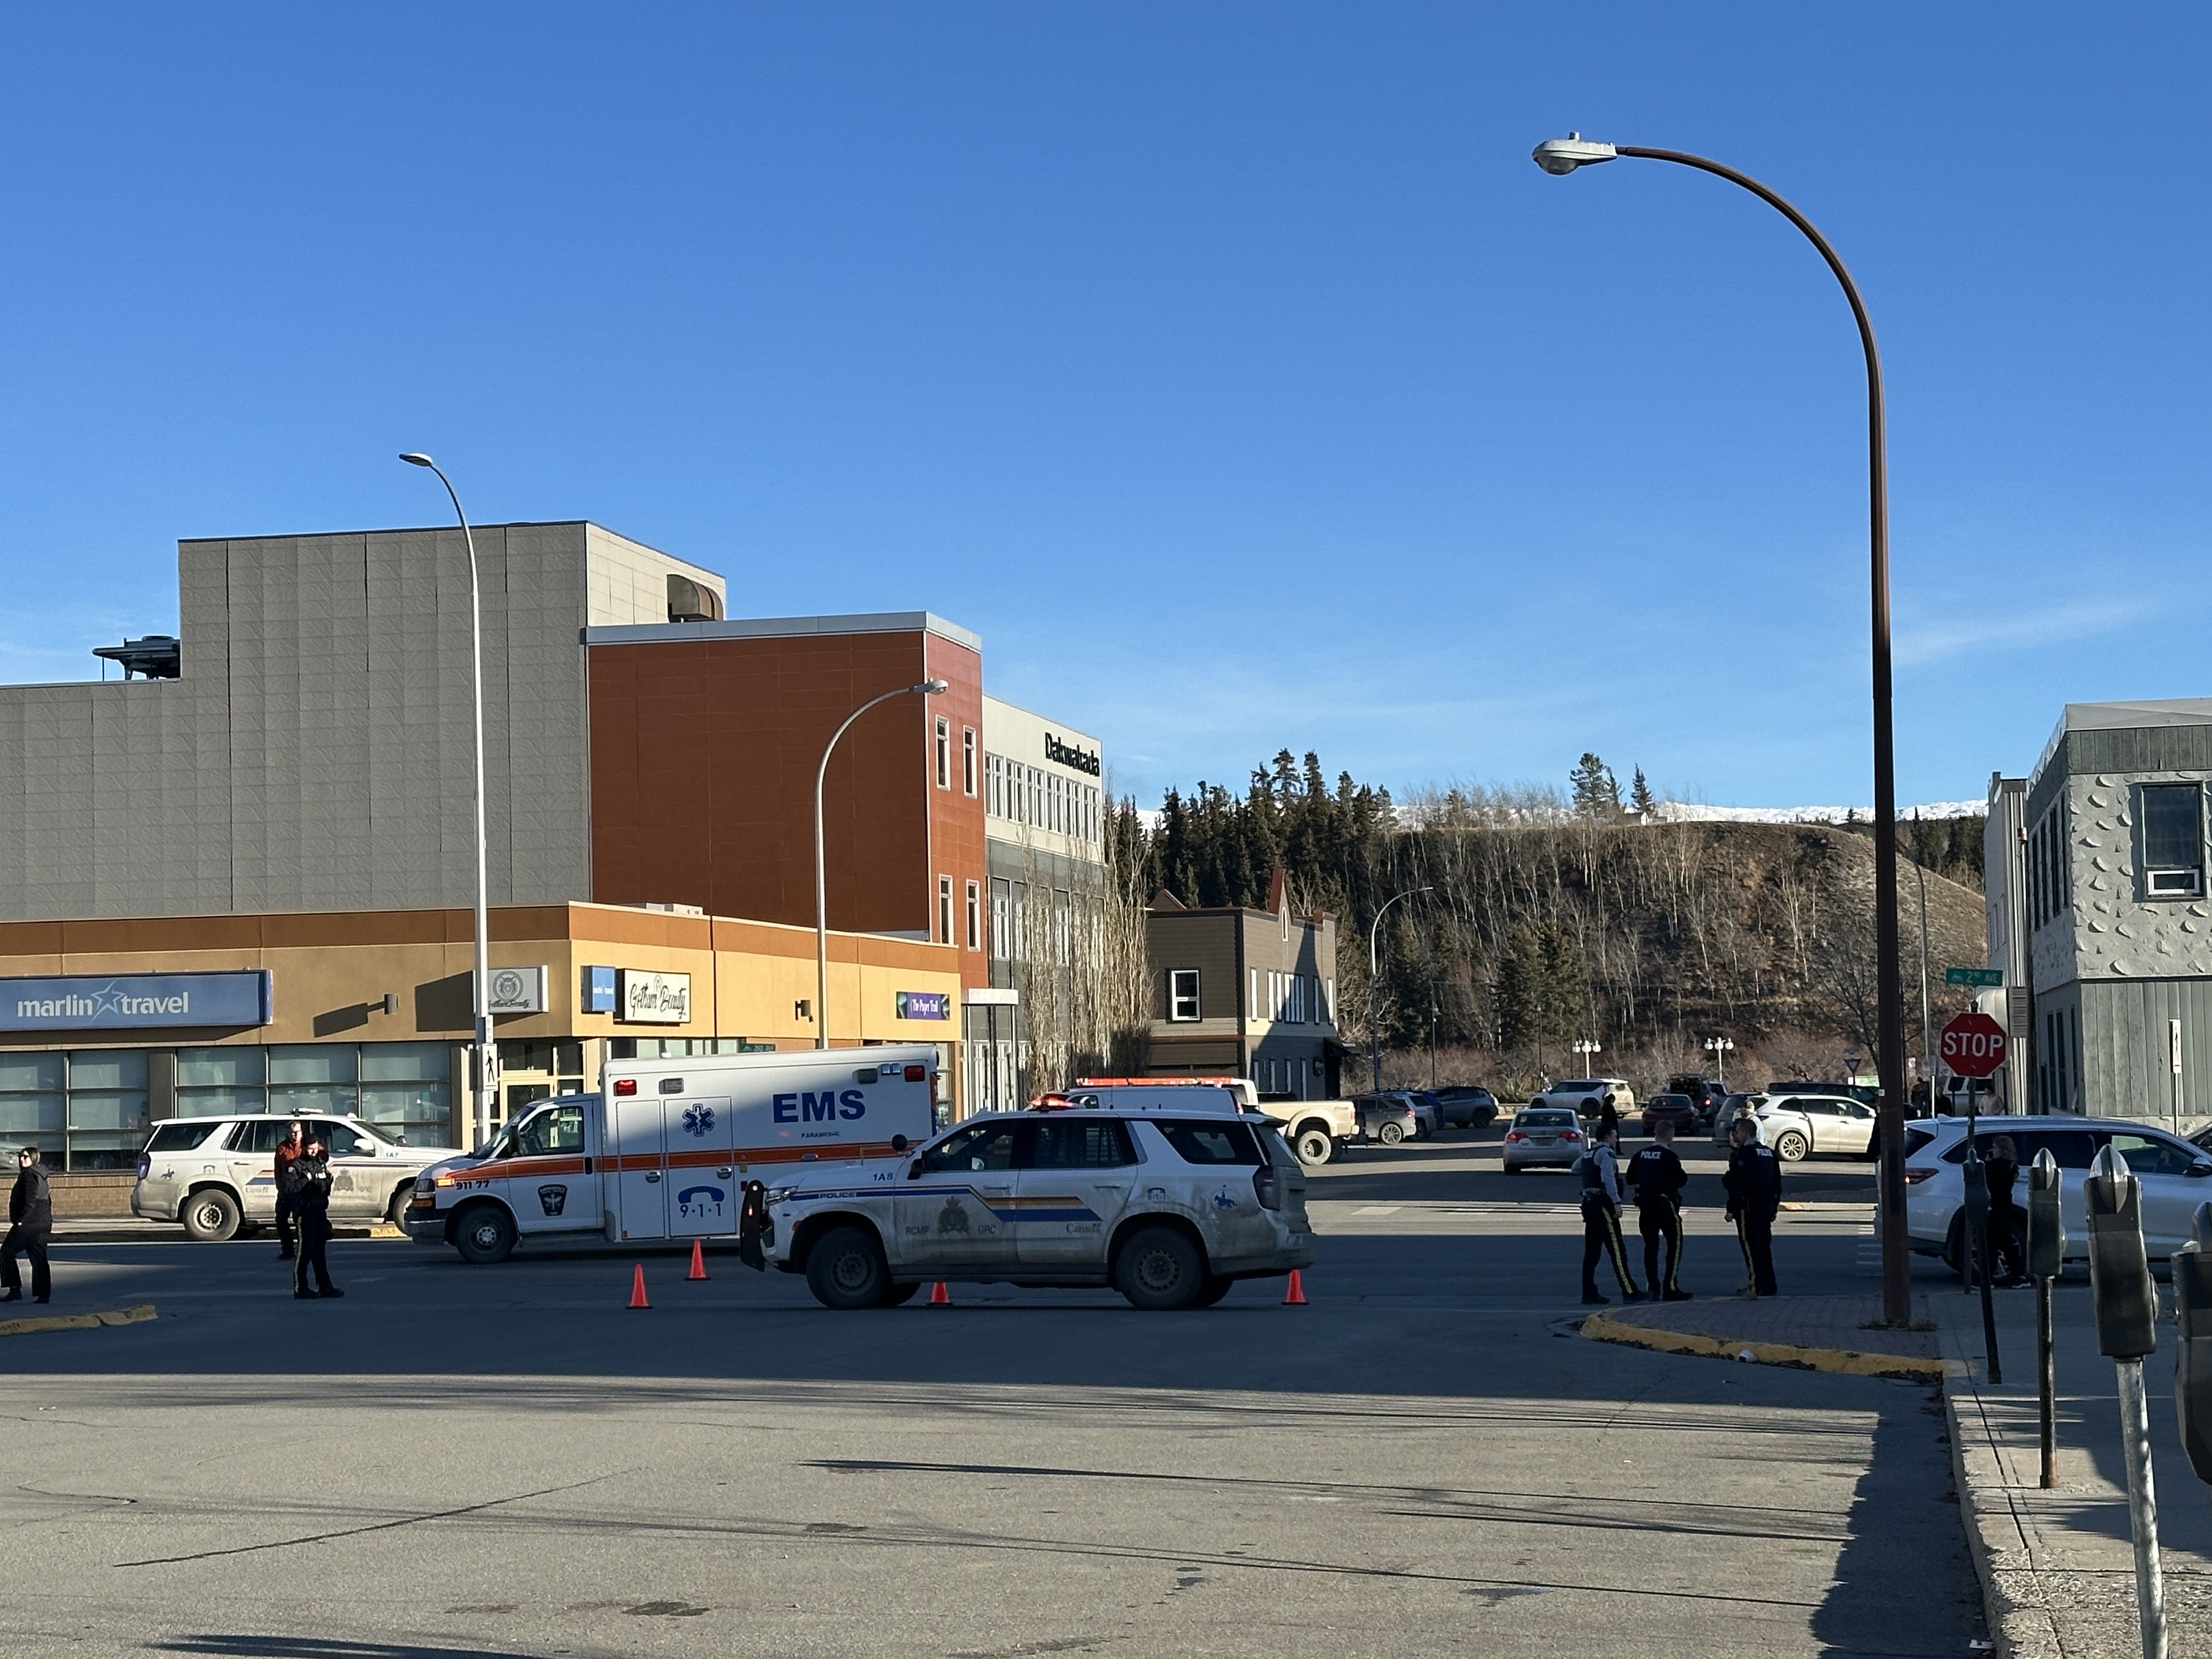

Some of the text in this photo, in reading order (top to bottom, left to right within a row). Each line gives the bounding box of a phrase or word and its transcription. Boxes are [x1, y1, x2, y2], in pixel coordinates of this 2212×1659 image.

[1045, 732, 1100, 777] Dakwakada
[1984, 973, 1999, 983] AVE
[18, 991, 189, 1017] marlin travel
[1944, 1032, 2004, 1057] STOP
[772, 1090, 866, 1123] EMS
[1640, 1151, 1661, 1159] POLICE
[873, 1172, 893, 1181] 1A8
[456, 1180, 490, 1190] 911 77
[906, 1226, 929, 1235] RCMP
[978, 1224, 996, 1234] GRC
